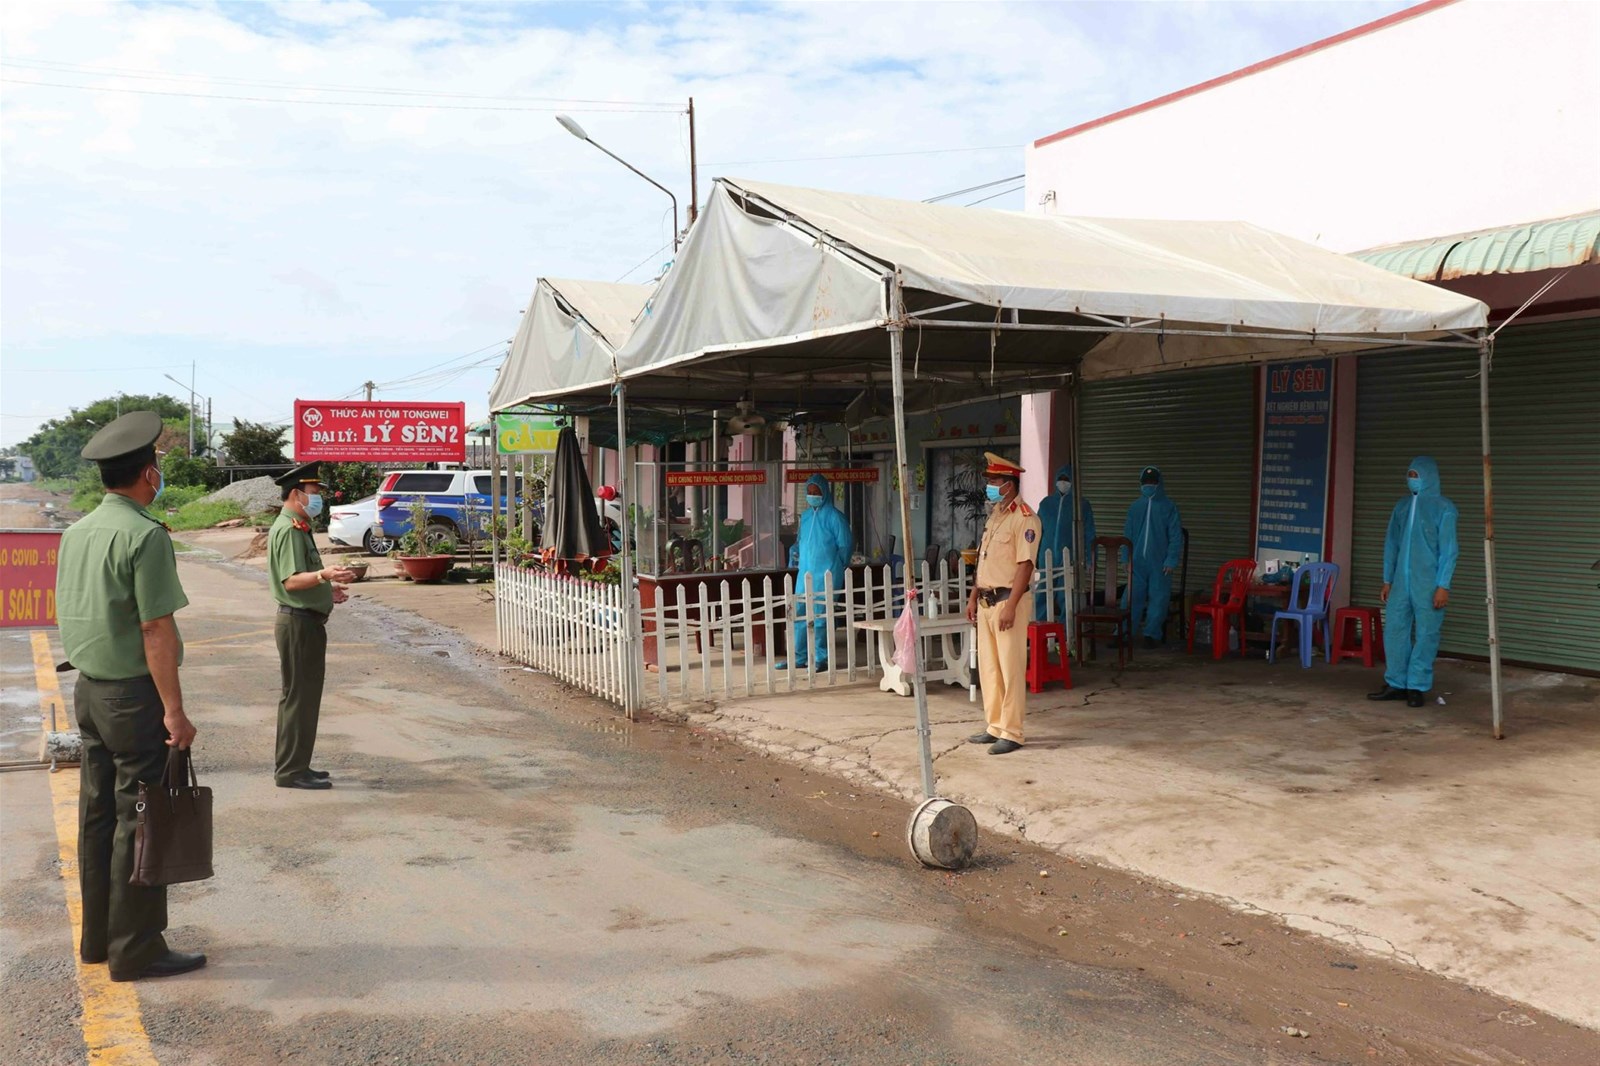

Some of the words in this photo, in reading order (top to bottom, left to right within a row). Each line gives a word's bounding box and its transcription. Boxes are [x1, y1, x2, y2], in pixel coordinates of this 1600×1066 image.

[1271, 365, 1291, 393] LÝ
[1293, 363, 1325, 392] SÊN
[330, 408, 359, 419] THỨC
[379, 407, 399, 419] TÔM
[403, 410, 449, 419] TONGWEI
[312, 430, 334, 445] ĐẠI
[363, 420, 395, 443] LÝ
[9, 581, 41, 620] SOÁT
